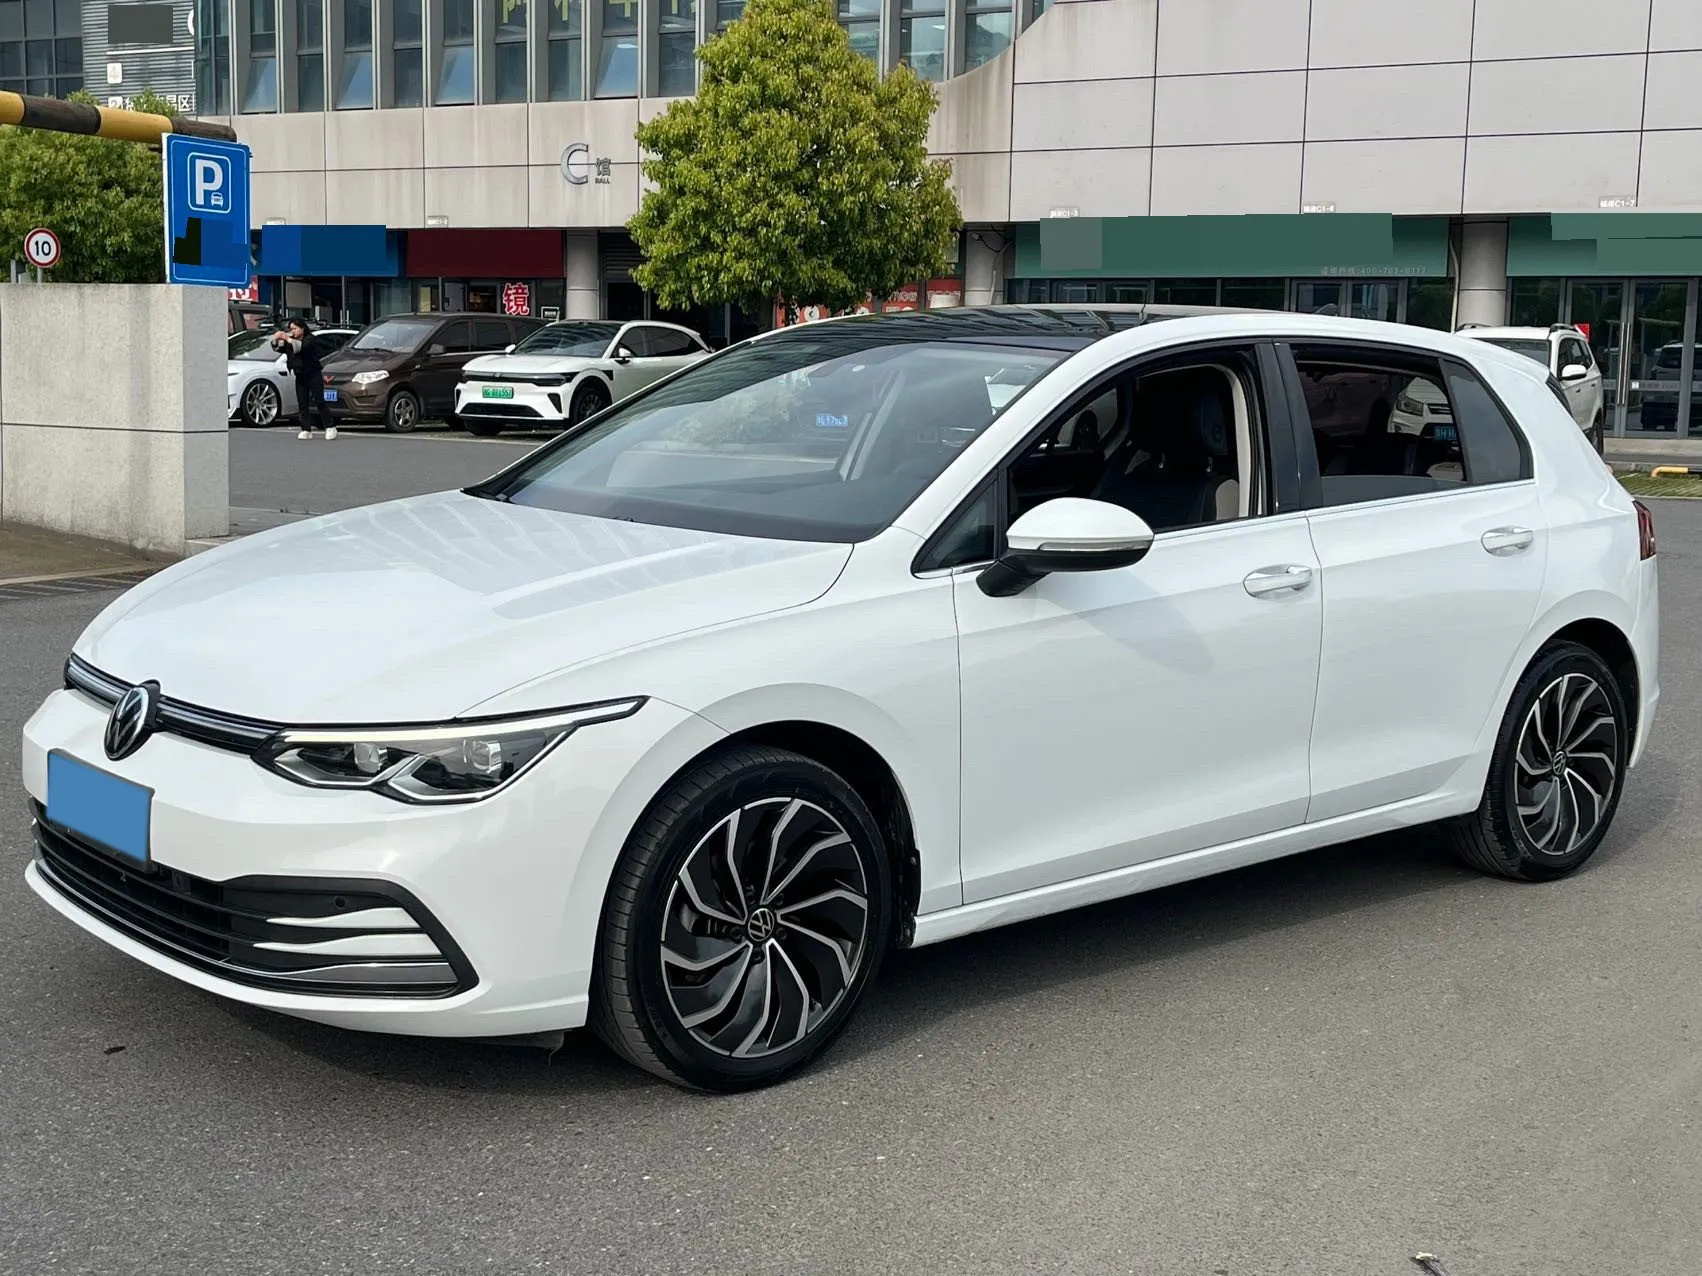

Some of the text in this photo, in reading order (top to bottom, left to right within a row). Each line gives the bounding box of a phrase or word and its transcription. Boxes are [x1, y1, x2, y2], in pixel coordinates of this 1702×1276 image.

[195, 158, 224, 206] P
[560, 143, 589, 185] C
[34, 240, 51, 257] 10
[502, 282, 530, 316] 镜
